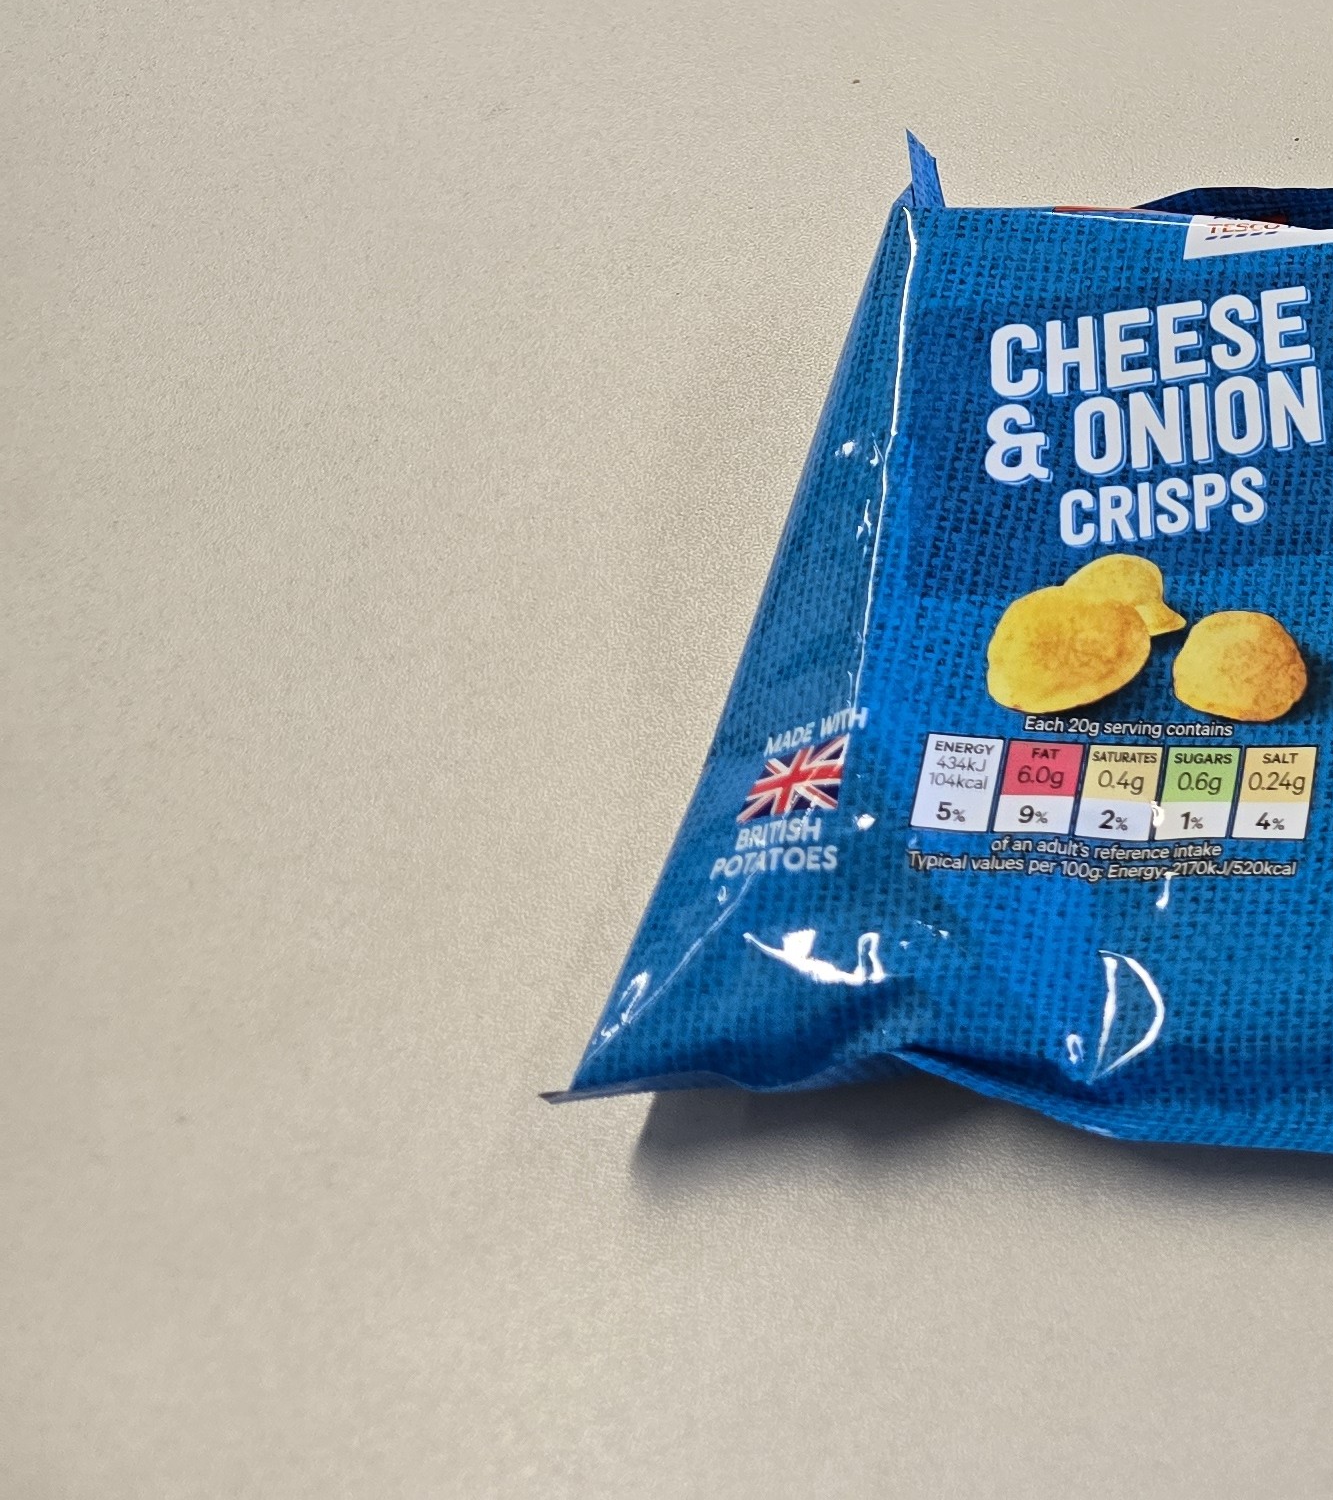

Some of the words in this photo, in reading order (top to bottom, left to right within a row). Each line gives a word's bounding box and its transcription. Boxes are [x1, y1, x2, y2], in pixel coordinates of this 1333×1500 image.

[989, 285, 1314, 398] CHEESE
[984, 403, 1053, 485] &
[1073, 366, 1326, 475] ONION
[1059, 466, 1266, 548] CRISPS
[763, 721, 816, 757] MADE
[820, 706, 869, 739] WITH
[1024, 716, 1065, 733] Each
[1068, 718, 1100, 736] 20g
[1100, 722, 1162, 739] serving
[1166, 722, 1234, 737] contains
[934, 740, 994, 755] ENERGY
[1031, 748, 1060, 761] FAT
[1092, 751, 1158, 764] SATURATES
[1174, 752, 1233, 765] SUGARS
[1262, 752, 1298, 764] SALT
[936, 756, 986, 772] 434kJ
[929, 772, 988, 790] 104kcal
[1017, 766, 1064, 789] 6.0g
[1098, 771, 1145, 794] 0.4g
[1177, 772, 1222, 794] 0.6g
[1247, 772, 1307, 796] 0.24g
[936, 802, 966, 823] 5%
[1018, 805, 1048, 824] 9%
[1099, 810, 1128, 831] 2%
[1180, 812, 1204, 830] 1%
[1255, 812, 1285, 831] 4%
[735, 817, 822, 850] BRITISH
[991, 838, 1011, 852] of
[1012, 840, 1033, 853] an
[1036, 841, 1090, 858] adult's
[1095, 843, 1171, 860] reference
[1173, 843, 1223, 858] intake
[709, 845, 838, 881] POTATOES
[909, 851, 968, 871] Typical
[971, 856, 1024, 870] values
[1028, 860, 1058, 876] per
[1172, 860, 1297, 875] 2170kJ/520kcal
